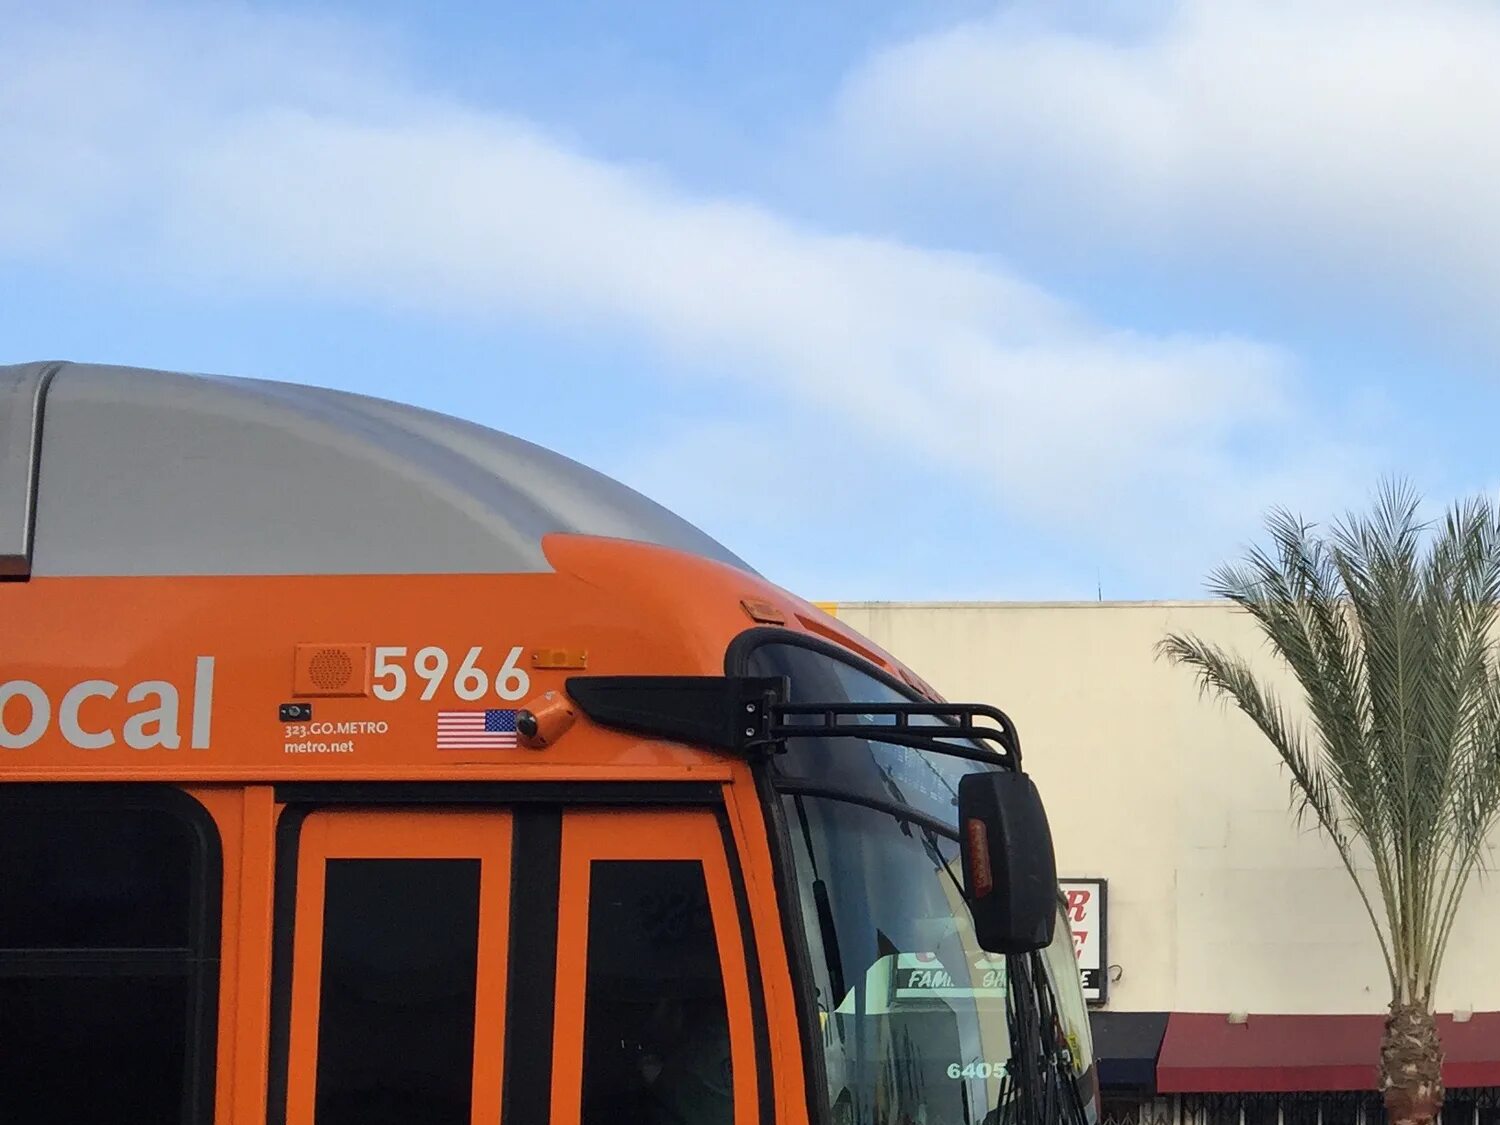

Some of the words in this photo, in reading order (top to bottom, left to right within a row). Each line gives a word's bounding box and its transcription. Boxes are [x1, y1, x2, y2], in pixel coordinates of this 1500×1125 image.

[372, 646, 530, 701] 5966
[285, 721, 388, 738] 323.GO.METRO
[284, 740, 354, 753] metro.net
